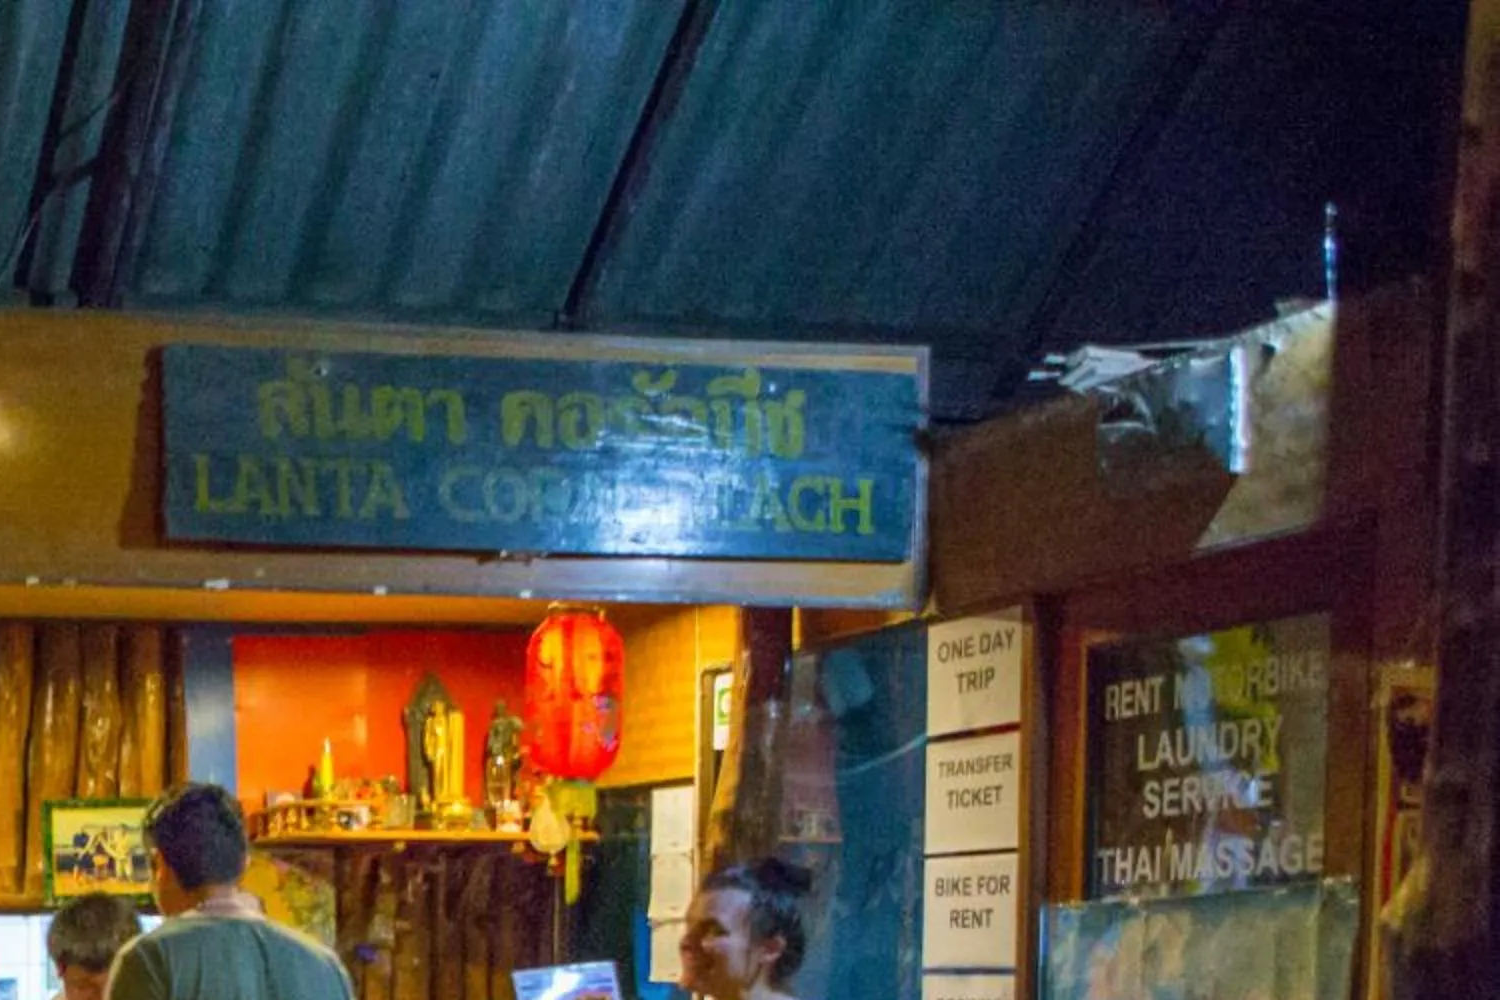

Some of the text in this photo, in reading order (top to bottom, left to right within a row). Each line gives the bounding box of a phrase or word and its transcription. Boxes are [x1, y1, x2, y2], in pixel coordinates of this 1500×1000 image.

[193, 454, 876, 534] LANTA COR EACH
[937, 627, 1015, 664] ONE DAY
[955, 667, 995, 694] TRIP
[1105, 675, 1164, 721] RENT
[1137, 715, 1284, 771] LAUNDRY
[938, 753, 1013, 779] TRANSFER
[946, 785, 1002, 810] TICKET
[1142, 770, 1273, 819] SERVICE
[1098, 831, 1324, 885] THAI MASSAGE
[935, 874, 1010, 897] BIKE FOR
[950, 909, 994, 929] RENT
